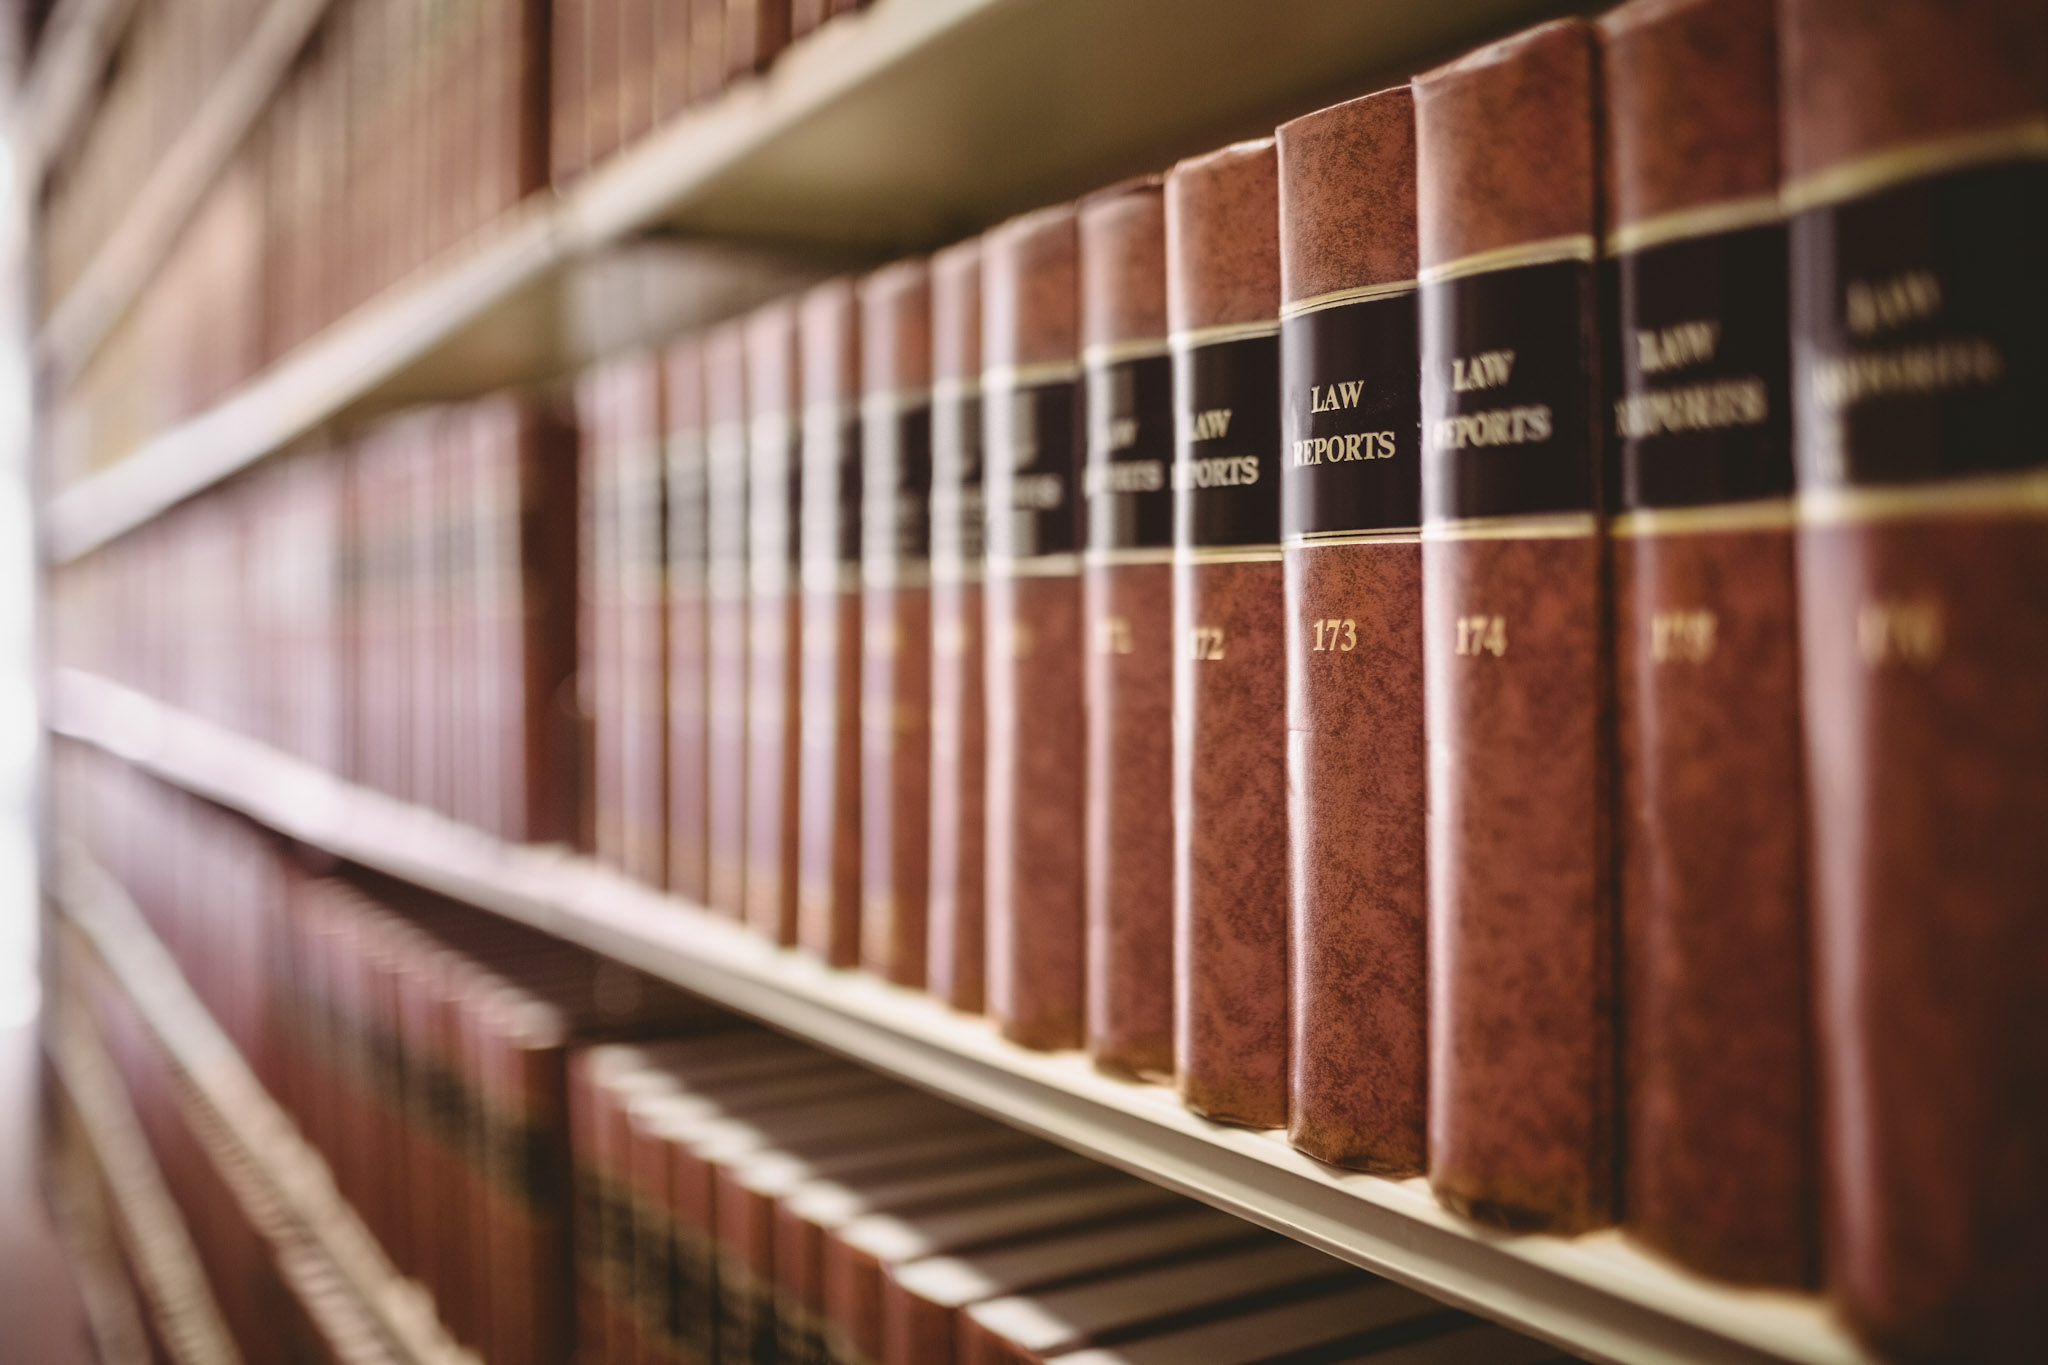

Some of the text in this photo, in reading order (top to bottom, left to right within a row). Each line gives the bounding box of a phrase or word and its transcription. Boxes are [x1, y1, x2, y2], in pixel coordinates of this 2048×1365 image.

[1452, 349, 1515, 392] LAW
[1311, 380, 1365, 413] LAW
[1293, 430, 1396, 467] REPORTS
[1171, 455, 1259, 491] PORTS
[1313, 618, 1357, 651] 173
[1456, 615, 1508, 656] 174
